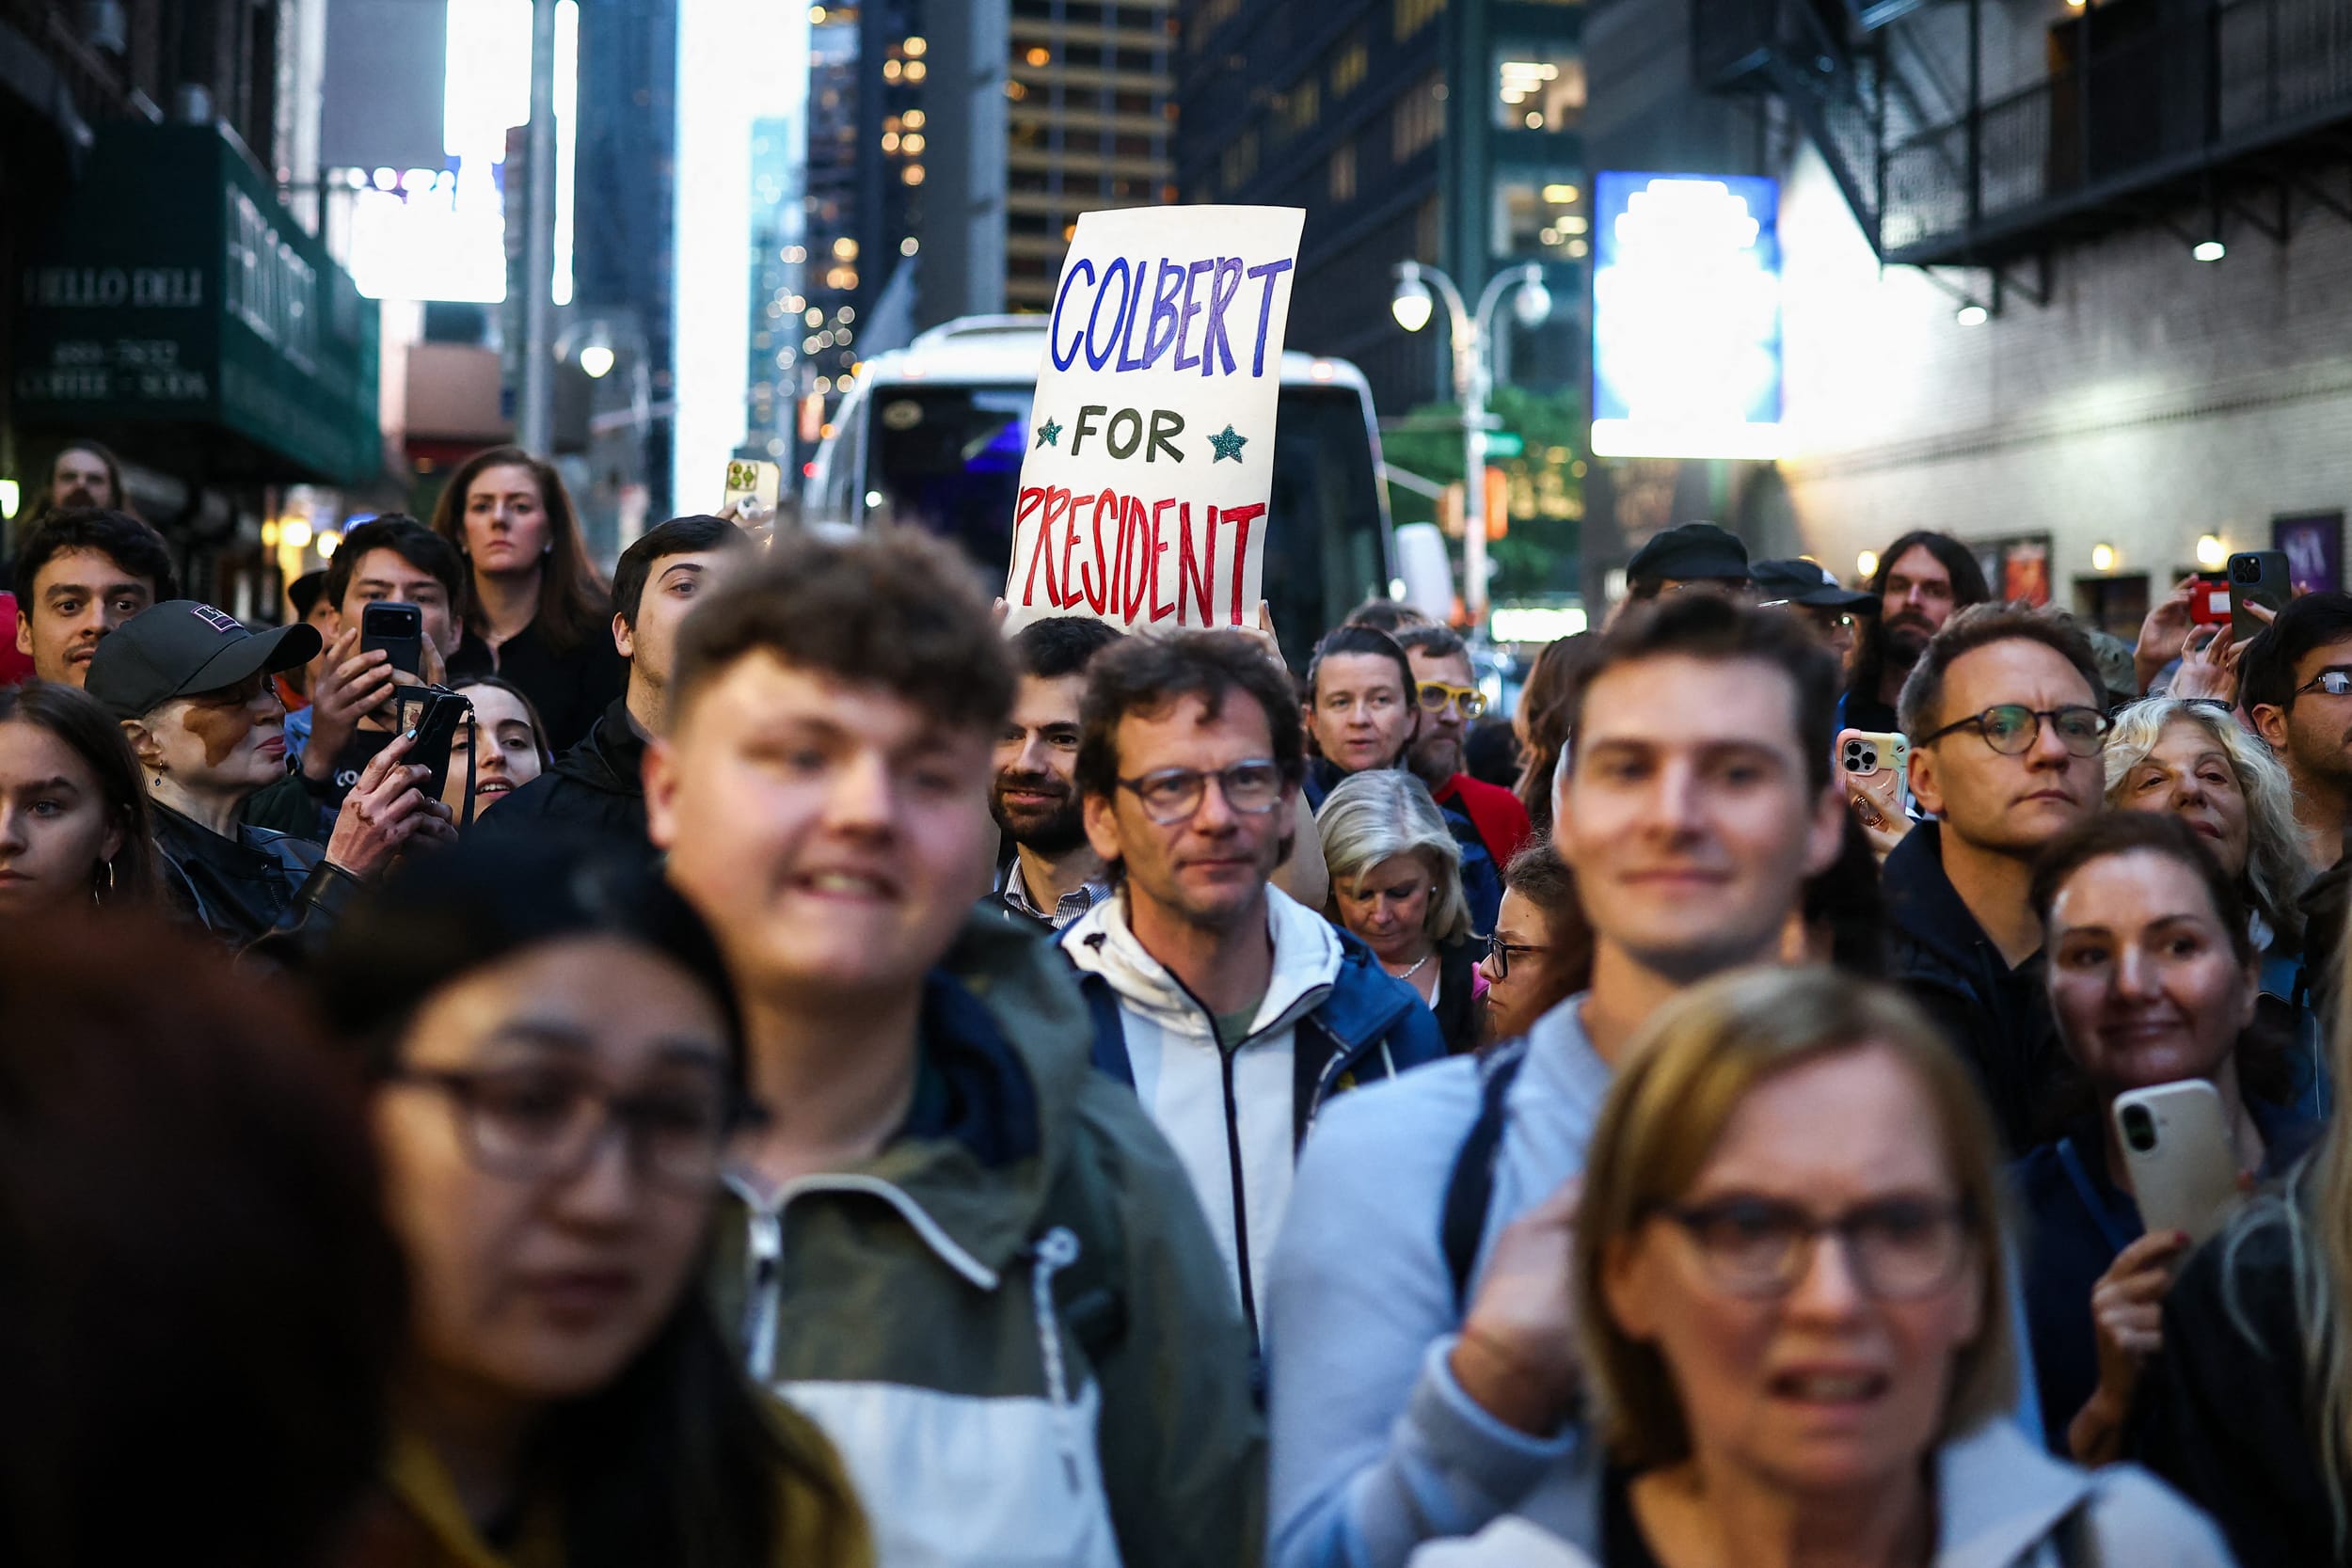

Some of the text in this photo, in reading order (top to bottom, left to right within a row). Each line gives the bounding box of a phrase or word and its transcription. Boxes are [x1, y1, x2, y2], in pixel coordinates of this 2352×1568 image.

[133, 267, 202, 308] DELI
[1051, 257, 1292, 377] COLBERT
[1072, 405, 1185, 463] FOR
[1017, 484, 1265, 627] PRESIDENT
